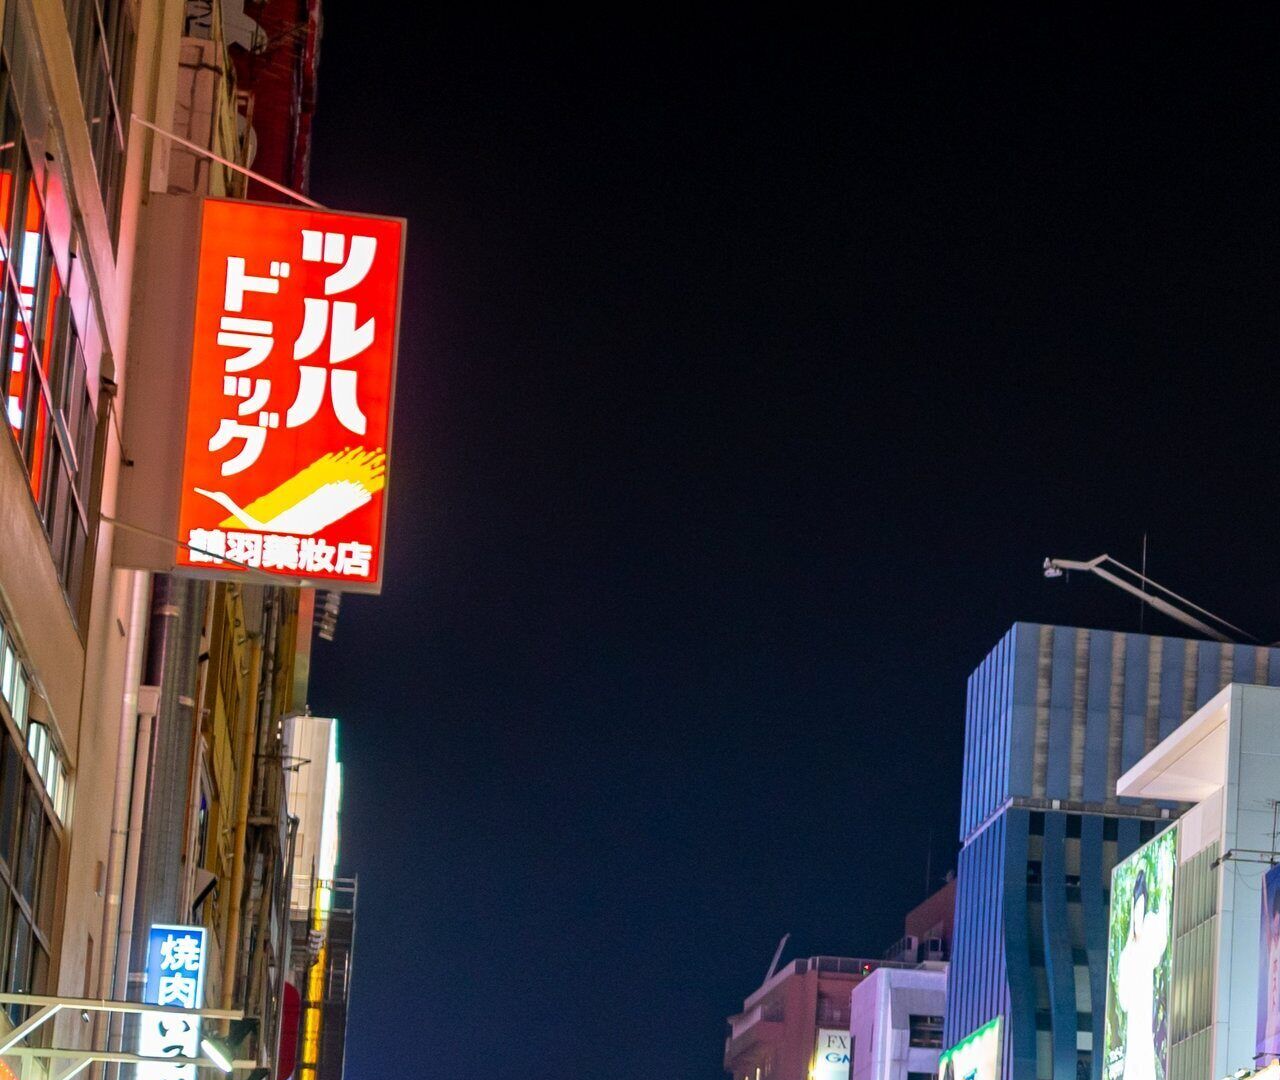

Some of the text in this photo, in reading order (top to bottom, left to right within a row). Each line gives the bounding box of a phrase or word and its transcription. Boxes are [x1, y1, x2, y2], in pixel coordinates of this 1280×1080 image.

[207, 257, 291, 477] ドラッグ
[286, 229, 378, 436] ツルハ
[158, 934, 201, 1007] 焼肉
